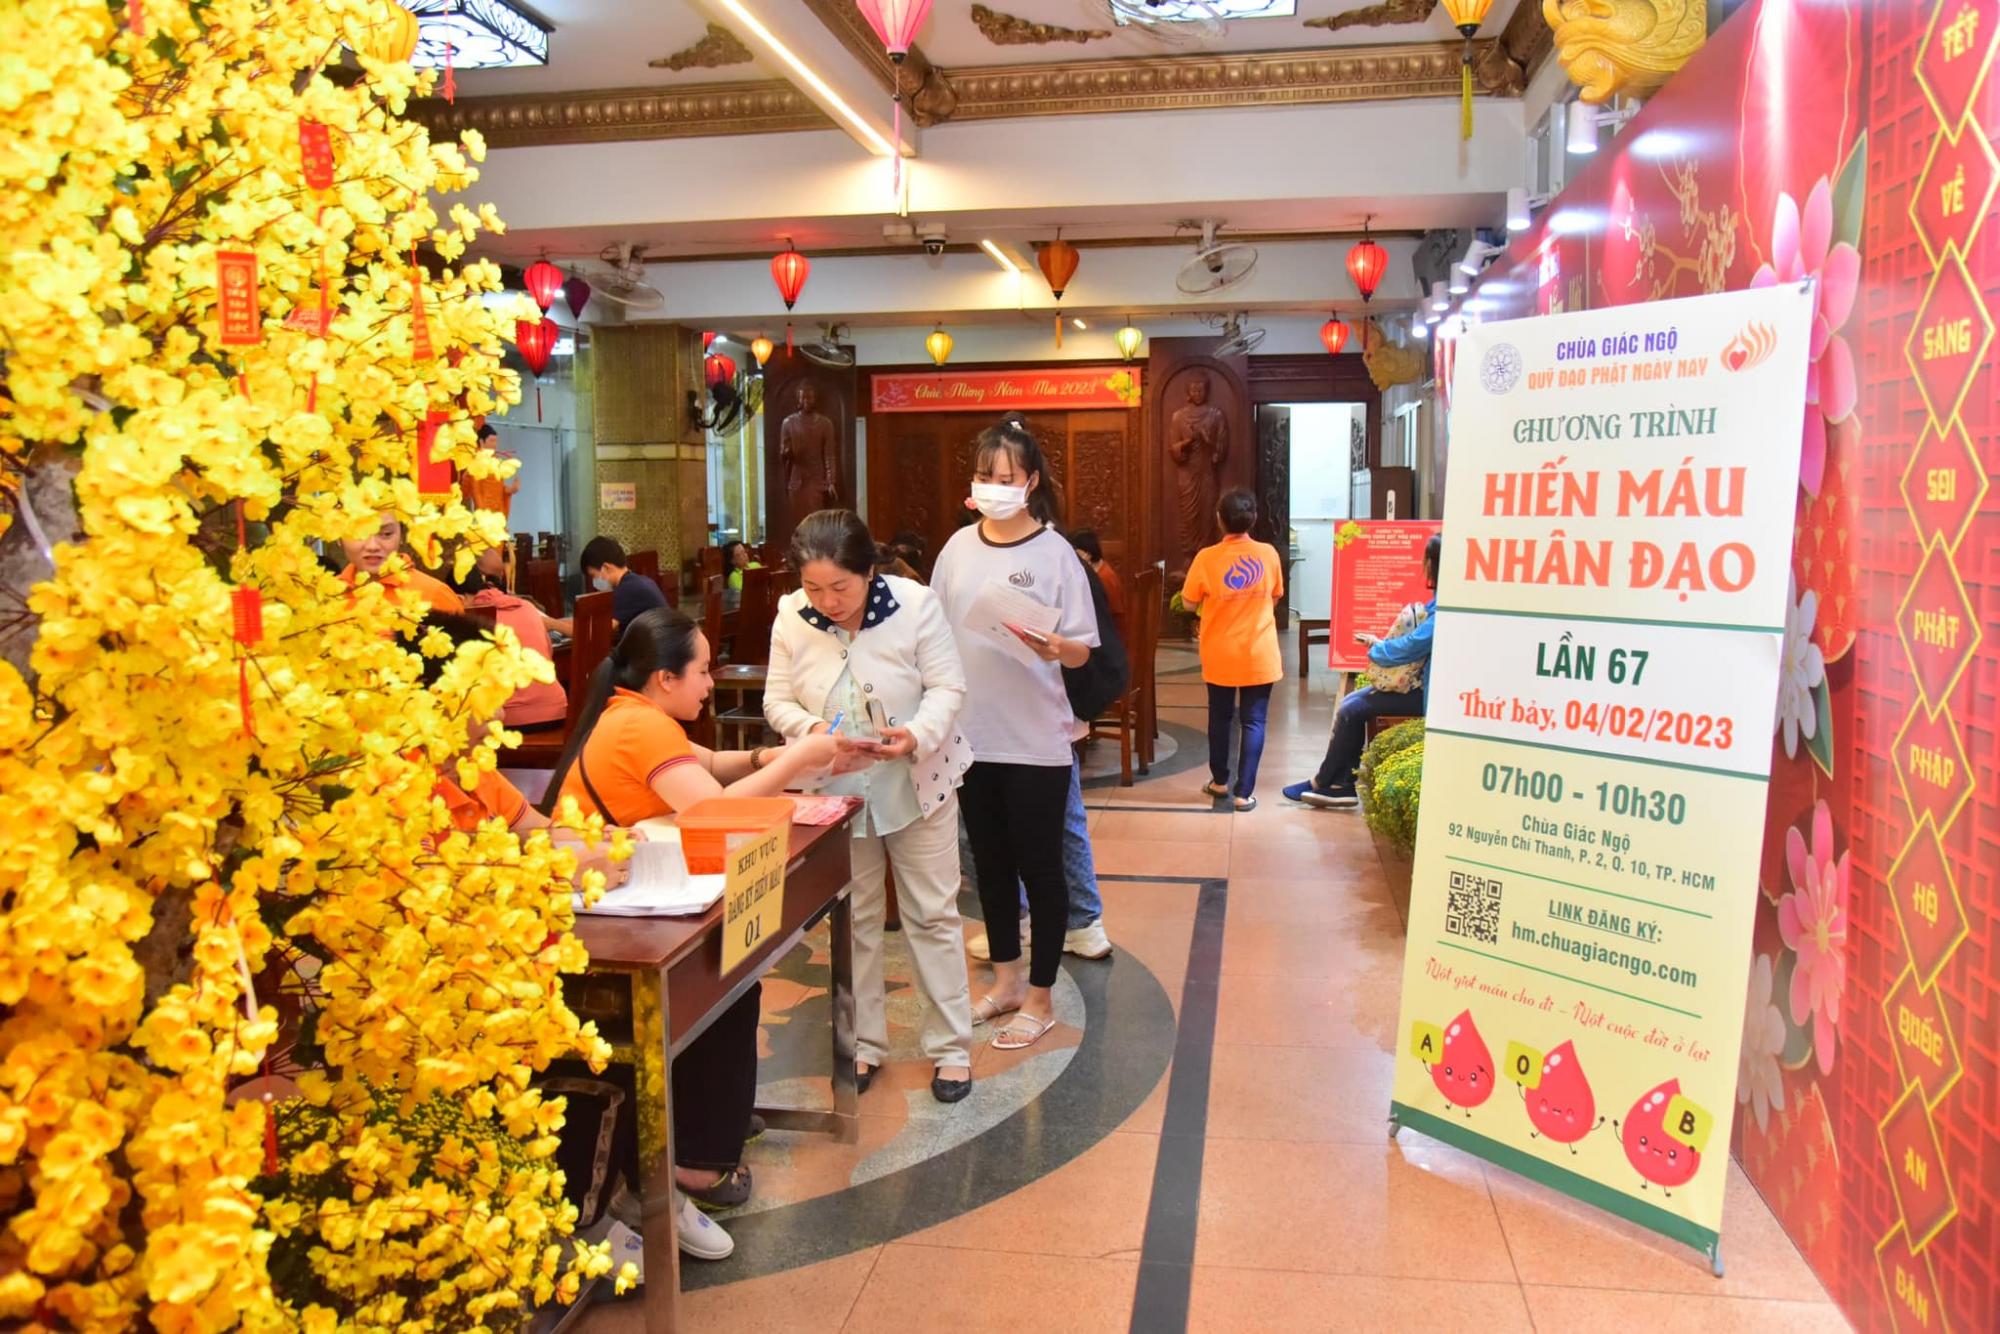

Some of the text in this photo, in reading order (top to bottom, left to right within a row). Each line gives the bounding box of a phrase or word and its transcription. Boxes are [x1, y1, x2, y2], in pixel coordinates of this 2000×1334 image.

[1557, 326, 1678, 361] CHÙA GIÁC NGỘ
[1923, 317, 1971, 360] SÁNG
[1060, 377, 1097, 396] 2023
[1528, 357, 1708, 390] QUỸ ĐẠO PHẬT NGÀY NAY
[1513, 404, 1718, 444] CHƯƠNG TRÌNH
[1482, 456, 1748, 518] HIẾN MÁU
[1464, 530, 1613, 587] NHÂN
[1628, 541, 1756, 603] ĐẠO
[1914, 607, 1959, 654] PHẬT
[1535, 631, 1650, 686] LẦN 67
[1459, 688, 1734, 750] Thứ bảy, 04/02/2023
[1910, 744, 1954, 789] PHÁP
[1481, 762, 1564, 804] 07h00
[1595, 782, 1687, 826] 10h30
[738, 836, 778, 875] KHU VỰC
[1448, 822, 1716, 891] 92 Nguyễn Chí Thanh, P. 2, Q. 10, TP. HCM
[1522, 814, 1631, 855] Chùa Giác Ngộ
[1549, 899, 1663, 942] LINK ĐĂNG KÝ:
[1913, 881, 1938, 928] HỘ
[745, 914, 761, 948] 01
[1511, 921, 1698, 988] hm.chuagiacngo.com
[1479, 984, 1508, 999] máu
[1512, 987, 1535, 1007] cho
[1539, 995, 1554, 1012] đi
[1607, 1024, 1639, 1040] cuộc
[1644, 1027, 1669, 1048] đời
[1900, 1005, 1943, 1067] QUỐC
[1420, 1033, 1433, 1053] A
[1678, 1110, 1695, 1136] B
[1905, 1146, 1927, 1192] AN
